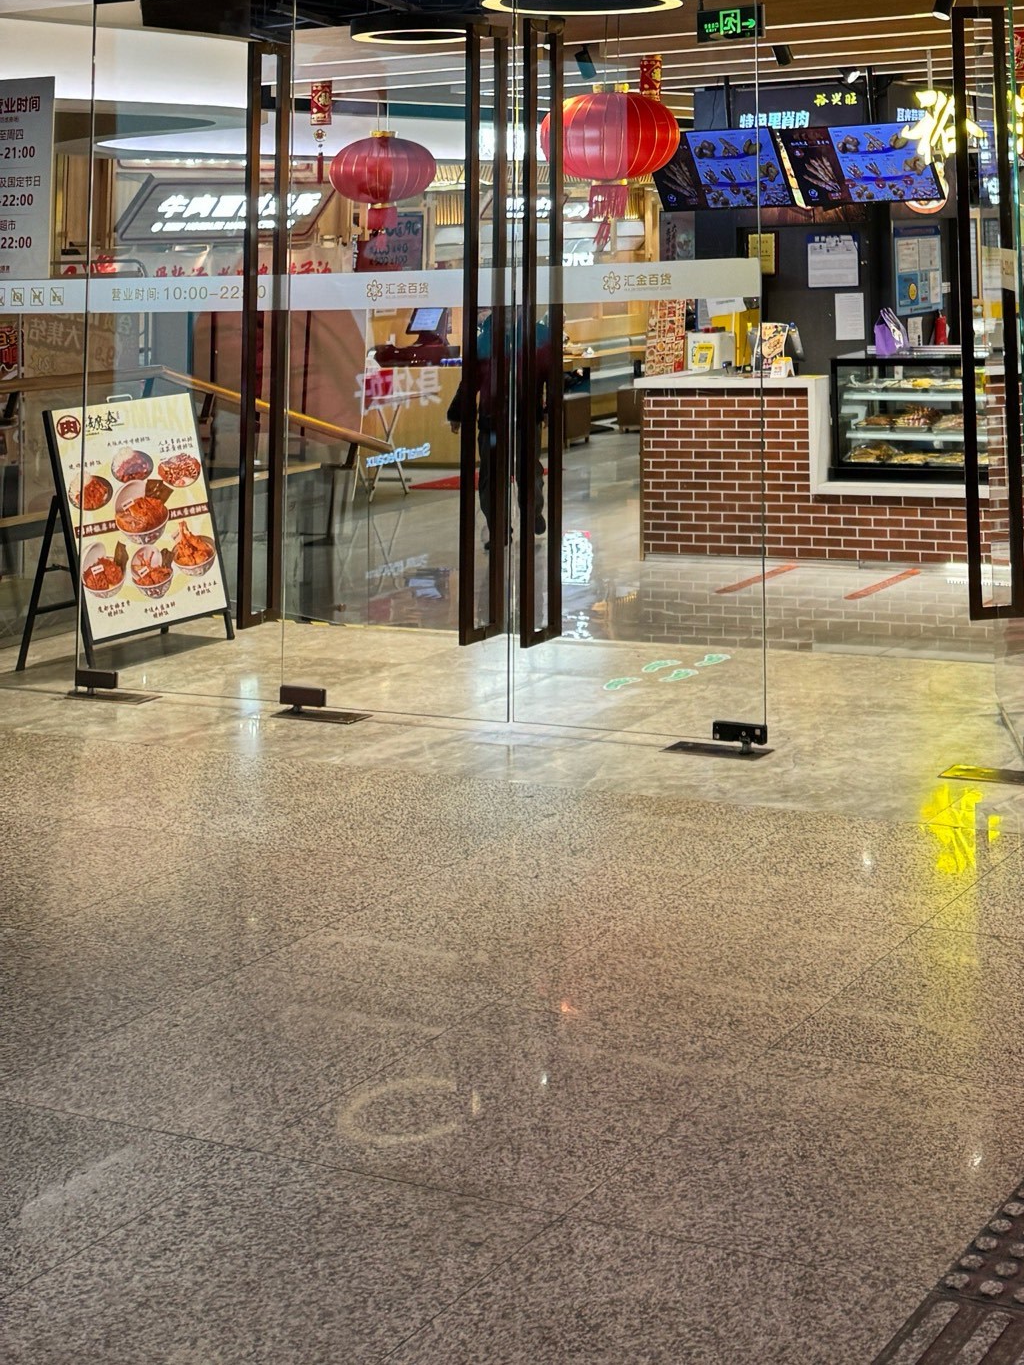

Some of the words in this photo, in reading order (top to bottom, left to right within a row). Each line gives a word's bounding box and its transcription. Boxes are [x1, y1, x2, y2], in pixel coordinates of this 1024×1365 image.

[0, 96, 41, 114] 业时间
[623, 272, 672, 287] 汇金百货
[385, 282, 429, 295] 汇金百货
